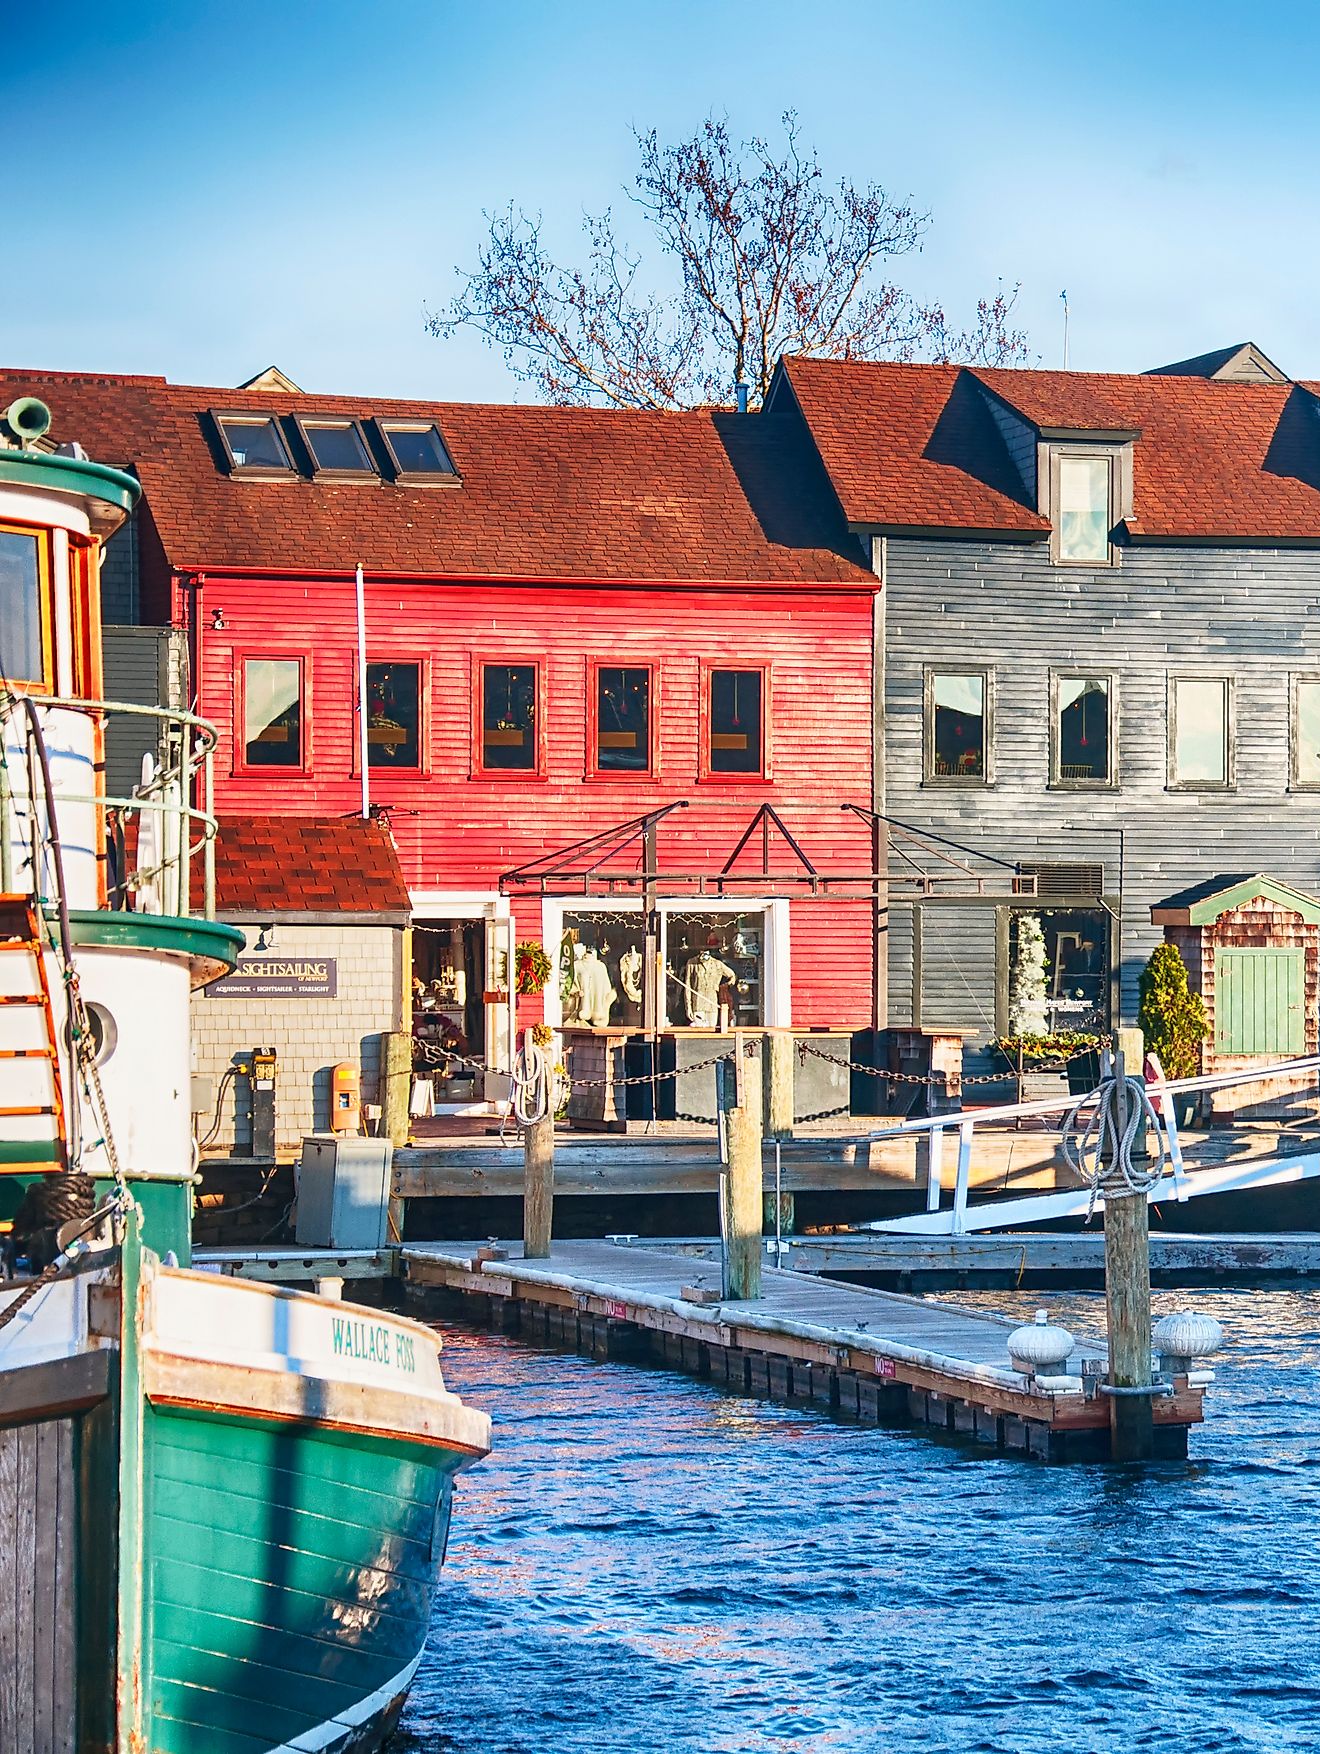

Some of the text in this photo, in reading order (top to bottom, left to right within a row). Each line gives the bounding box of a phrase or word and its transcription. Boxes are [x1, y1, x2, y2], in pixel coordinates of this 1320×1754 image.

[242, 963, 327, 976] SIGHTSAILING
[332, 1318, 415, 1373] WALLACE FOSS
